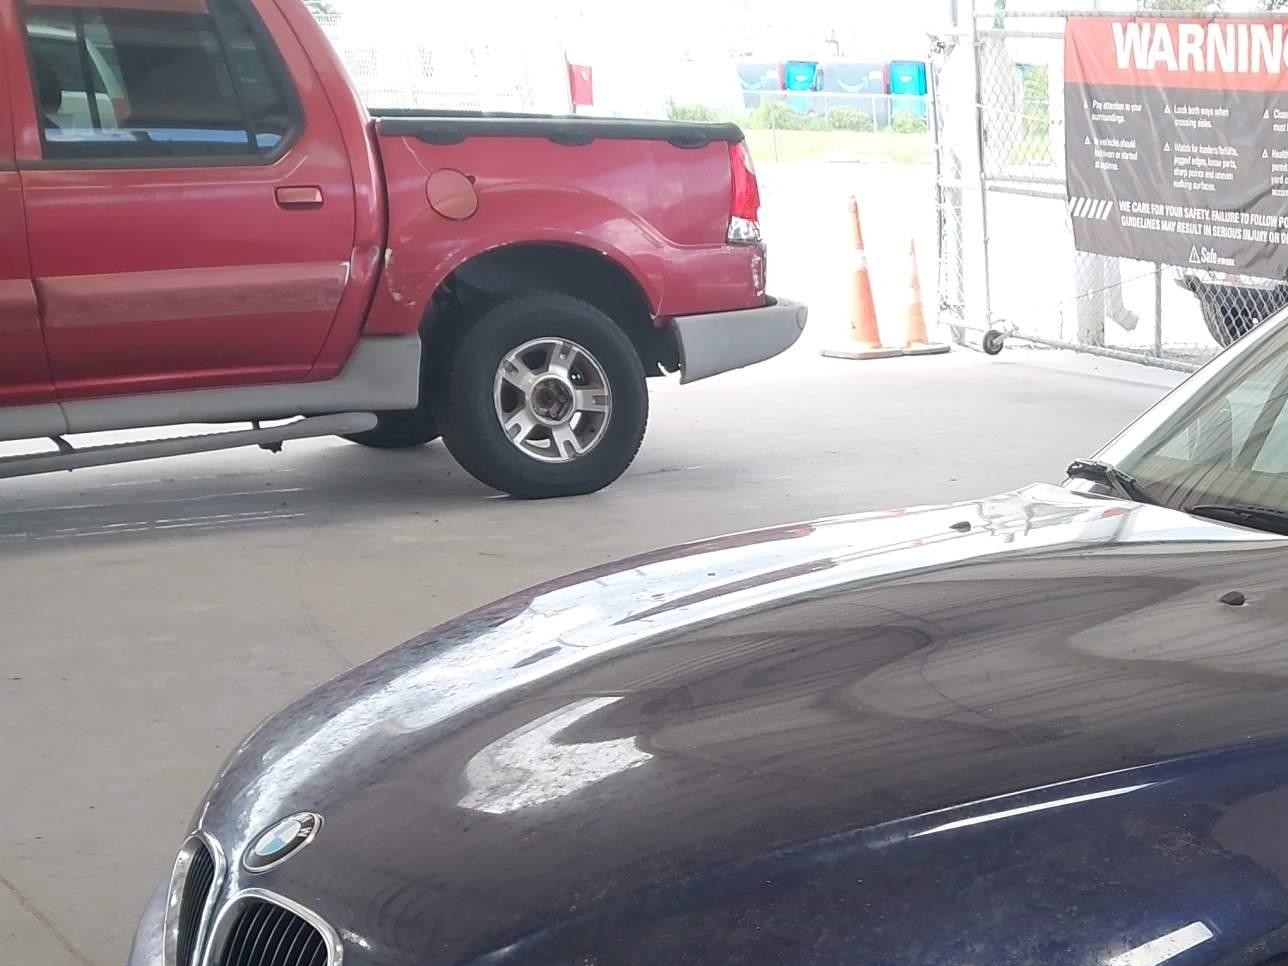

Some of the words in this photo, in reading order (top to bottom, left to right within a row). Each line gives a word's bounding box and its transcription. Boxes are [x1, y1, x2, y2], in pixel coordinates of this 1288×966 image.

[1119, 200, 1131, 212] WE
[1132, 201, 1150, 215] CARE
[1150, 203, 1164, 216] FOR
[1165, 204, 1183, 218] YOUR
[1212, 209, 1239, 223] FAILURE
[1240, 212, 1250, 225] TO
[1250, 213, 1278, 228] FOLLOW
[1121, 216, 1160, 231] GUIDELINES
[1162, 220, 1176, 232] MAY
[1176, 222, 1202, 235] RESULT
[1203, 224, 1211, 236] IN
[1212, 225, 1242, 240] SERIOUS
[1242, 228, 1268, 242] INJURY
[1269, 230, 1280, 243] OR
[1200, 246, 1217, 264] Safe
